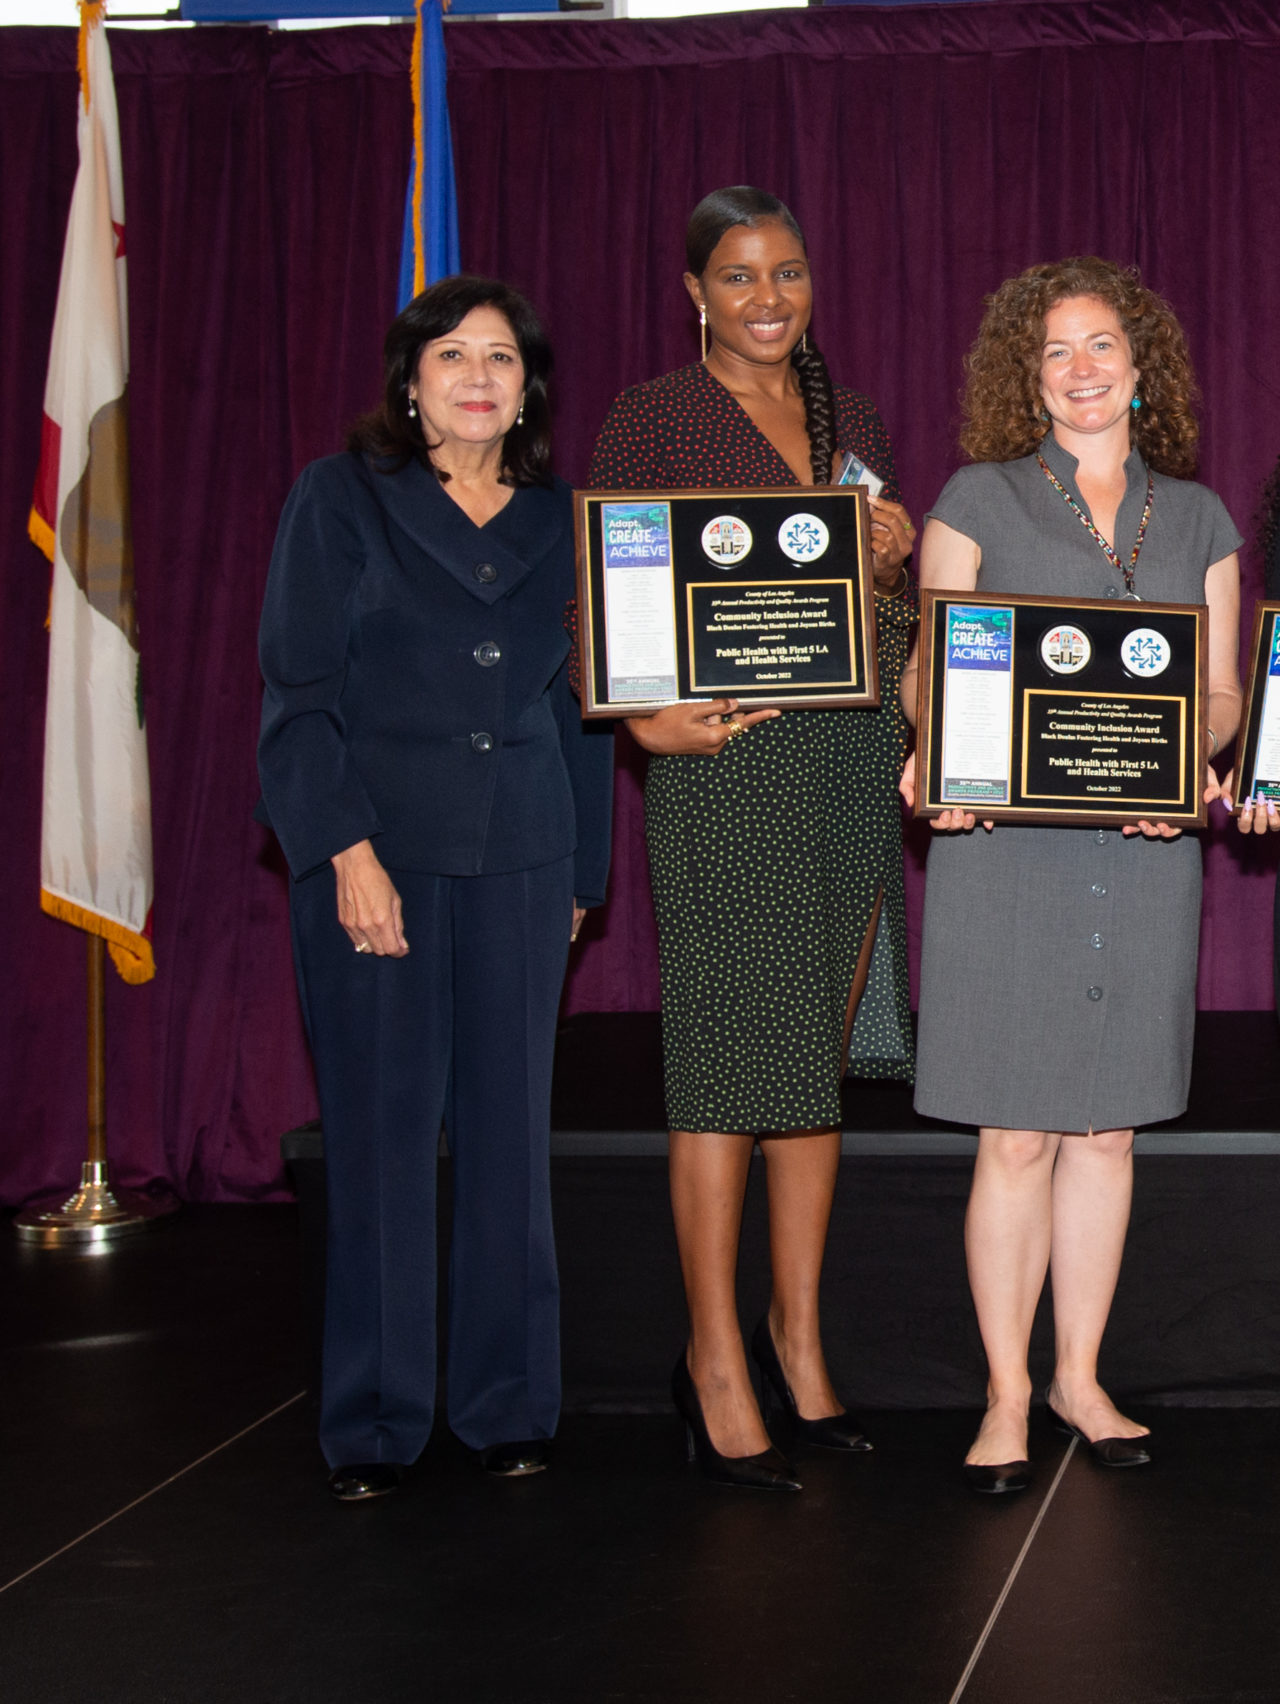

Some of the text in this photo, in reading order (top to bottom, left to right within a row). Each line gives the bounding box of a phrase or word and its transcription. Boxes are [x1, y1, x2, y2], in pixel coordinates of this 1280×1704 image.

[610, 545, 666, 557] ACHIEVE
[714, 610, 827, 621] Community Inclusion Award
[716, 649, 741, 657] Public
[743, 648, 769, 656] Health
[770, 646, 787, 655] with
[789, 646, 807, 654] First
[816, 645, 829, 653] LA
[952, 648, 1007, 661] ACHIEVE
[752, 656, 778, 664] Health
[779, 655, 811, 663] Services
[1049, 722, 1095, 732] Community
[1098, 724, 1132, 732] Inclusion
[1049, 758, 1073, 766] Public
[1075, 758, 1100, 767] Health
[1120, 760, 1139, 768] First
[1147, 761, 1159, 769] LA
[1084, 768, 1108, 776] Health
[1110, 769, 1141, 777] Services
